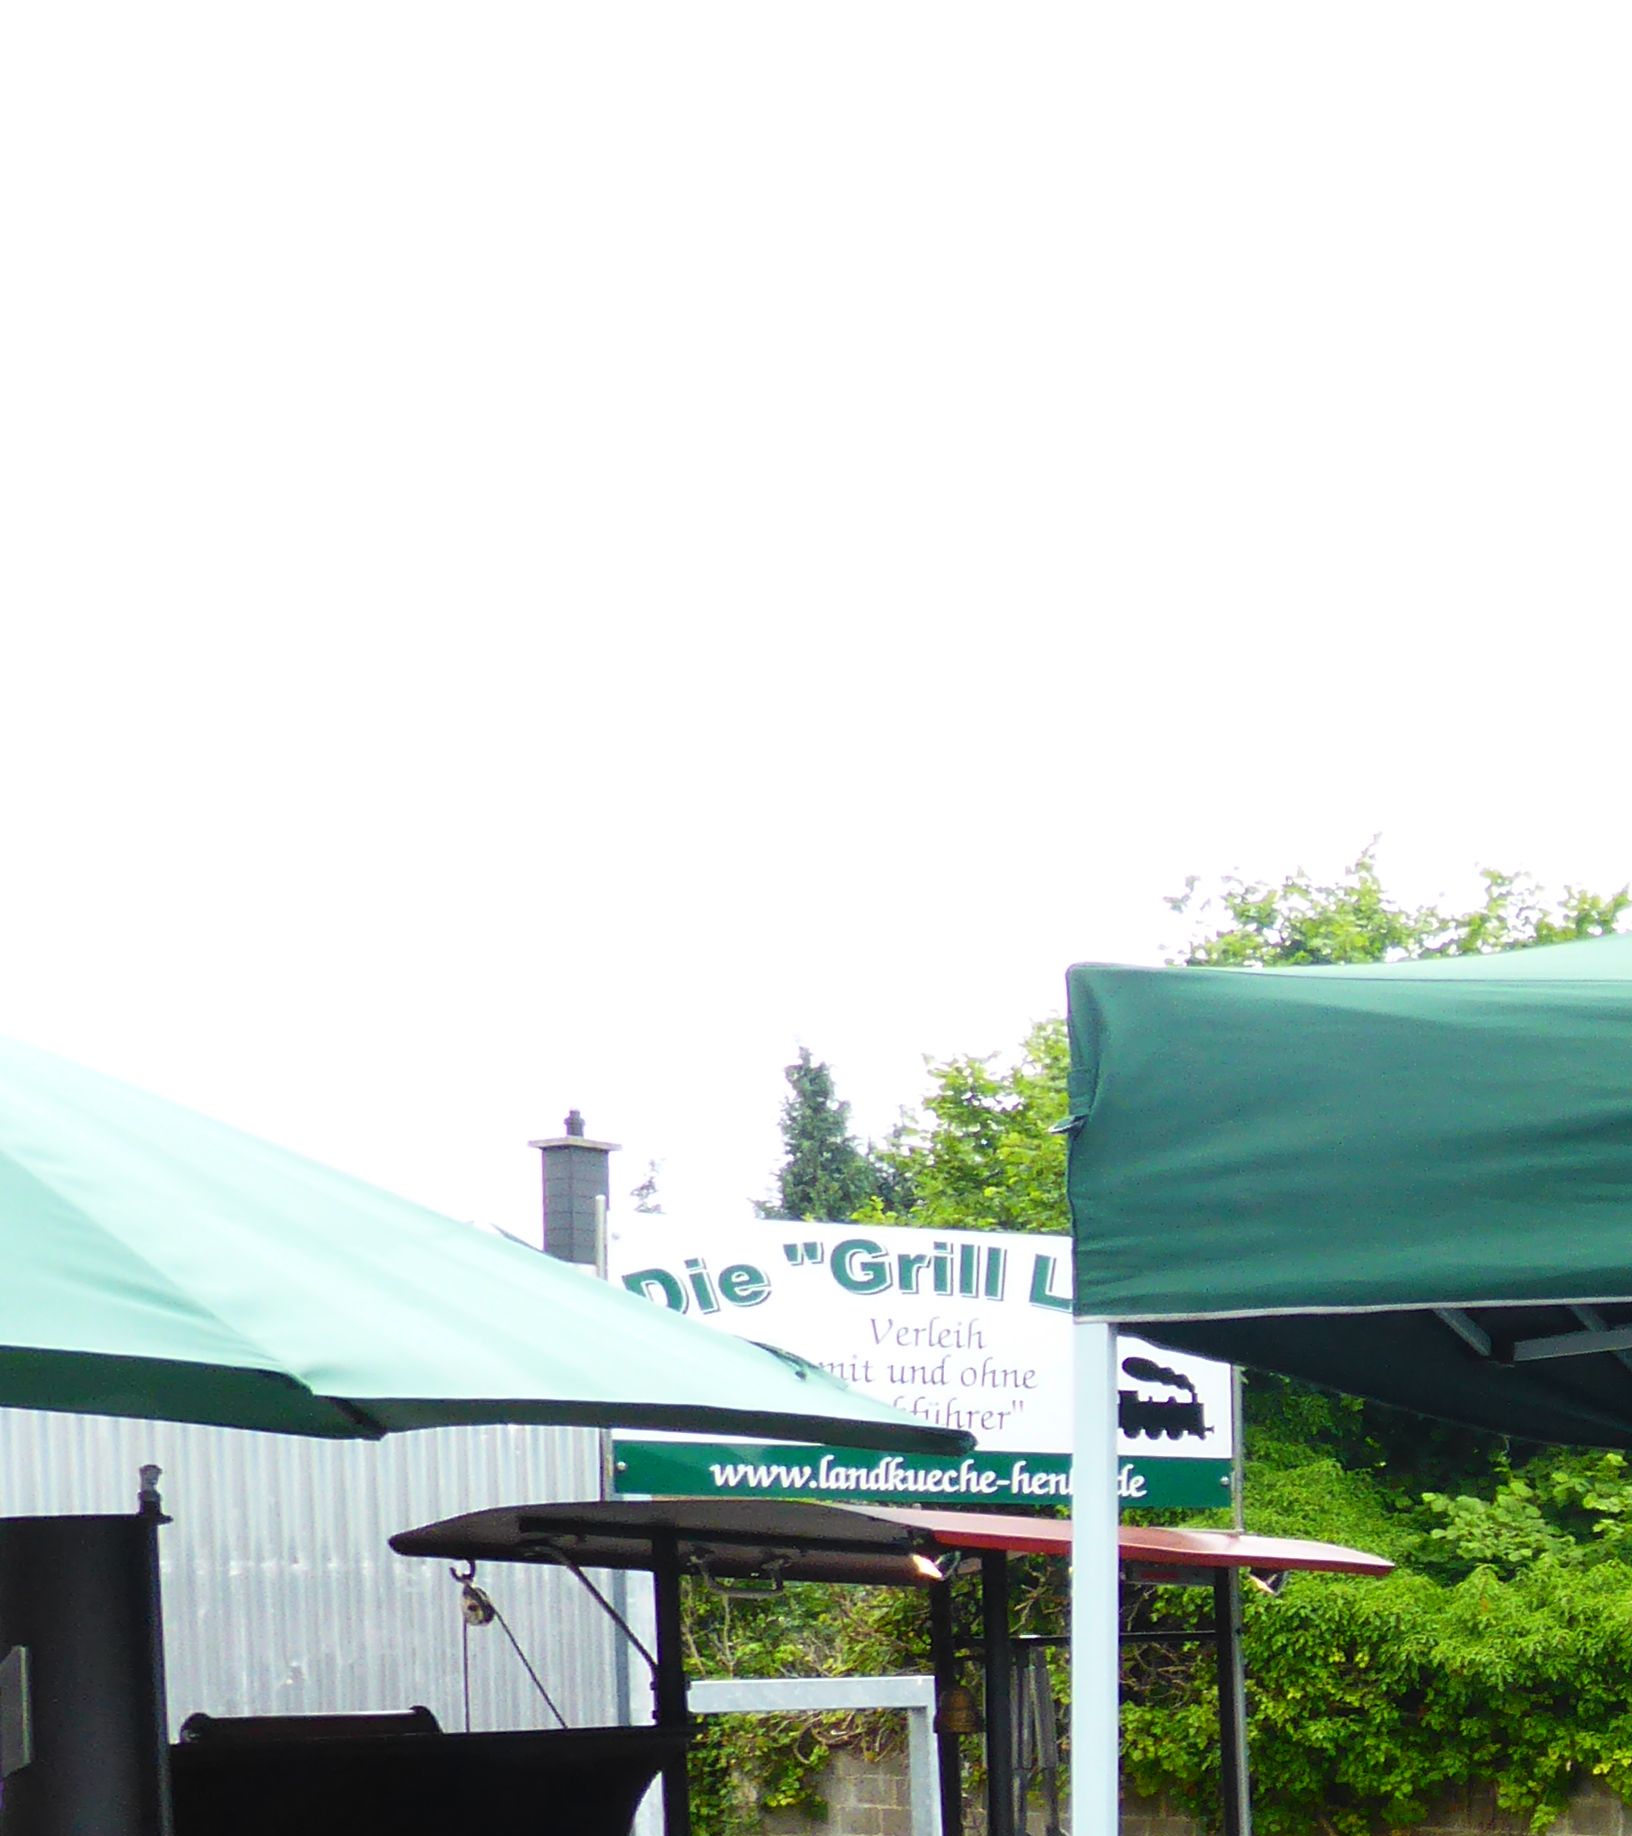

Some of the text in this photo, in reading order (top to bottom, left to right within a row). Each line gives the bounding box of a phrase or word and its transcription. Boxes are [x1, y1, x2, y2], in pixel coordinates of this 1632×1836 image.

[621, 1238, 1074, 1315] Die "Grill L
[870, 1316, 988, 1350] Verleih
[887, 1354, 952, 1386] und
[960, 1356, 1039, 1390] ohne
